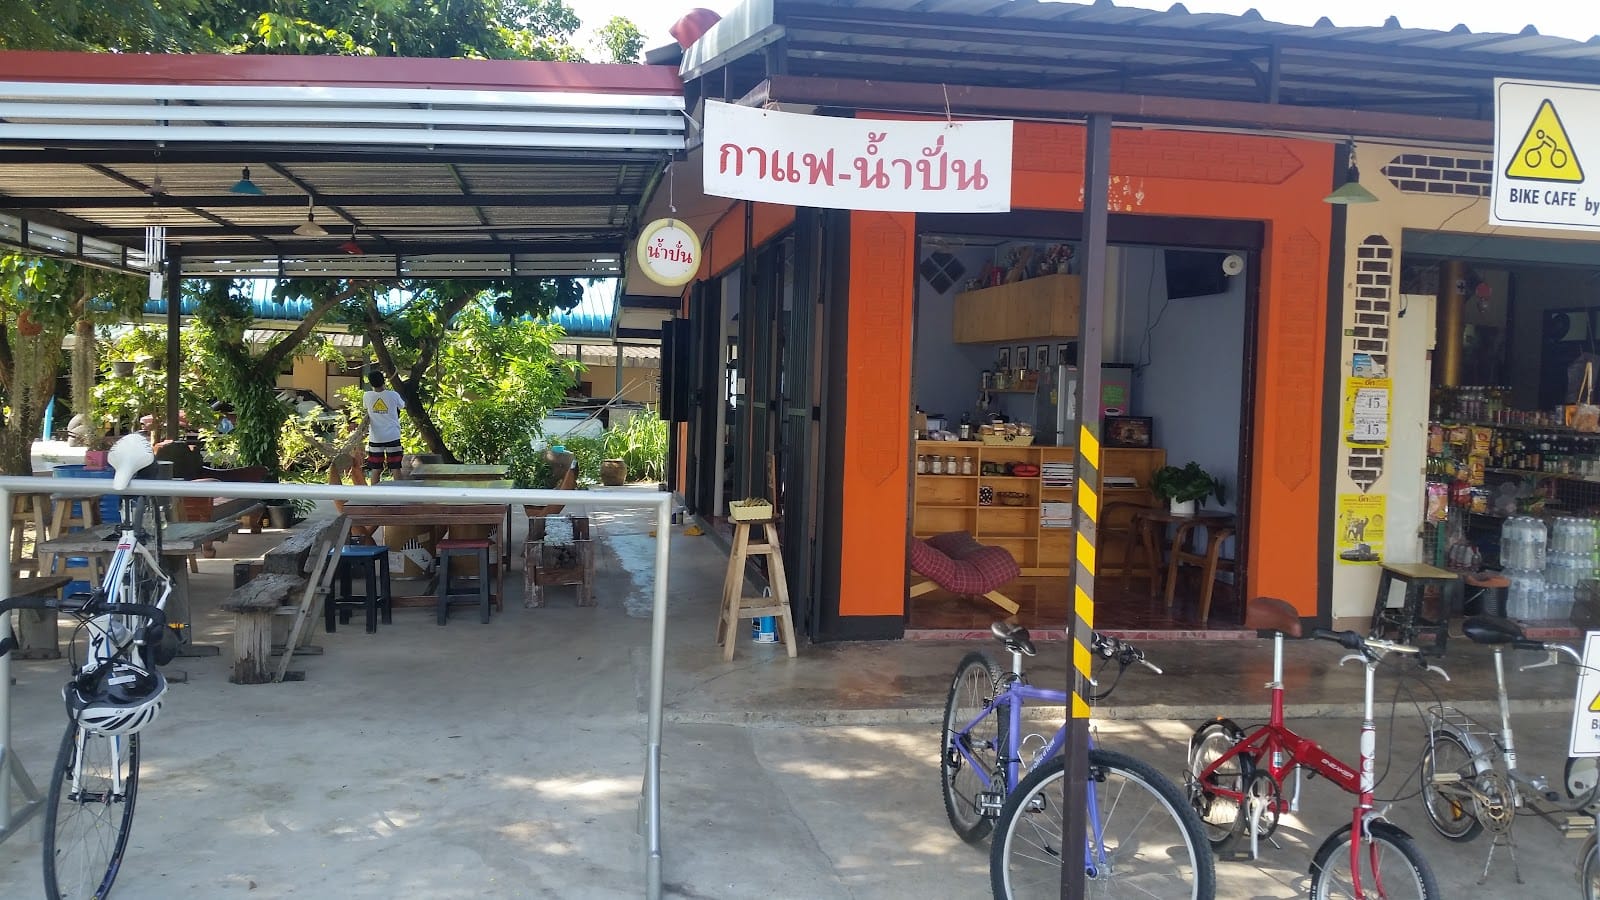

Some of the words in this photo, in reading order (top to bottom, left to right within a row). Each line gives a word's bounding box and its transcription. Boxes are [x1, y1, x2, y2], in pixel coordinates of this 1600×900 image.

[719, 131, 989, 191] กาแฟ-น้ำปั่น
[1509, 188, 1540, 205] BIKE
[1544, 190, 1577, 207] CAFE
[1584, 197, 1600, 216] by
[647, 238, 693, 264] น้ำปั่น
